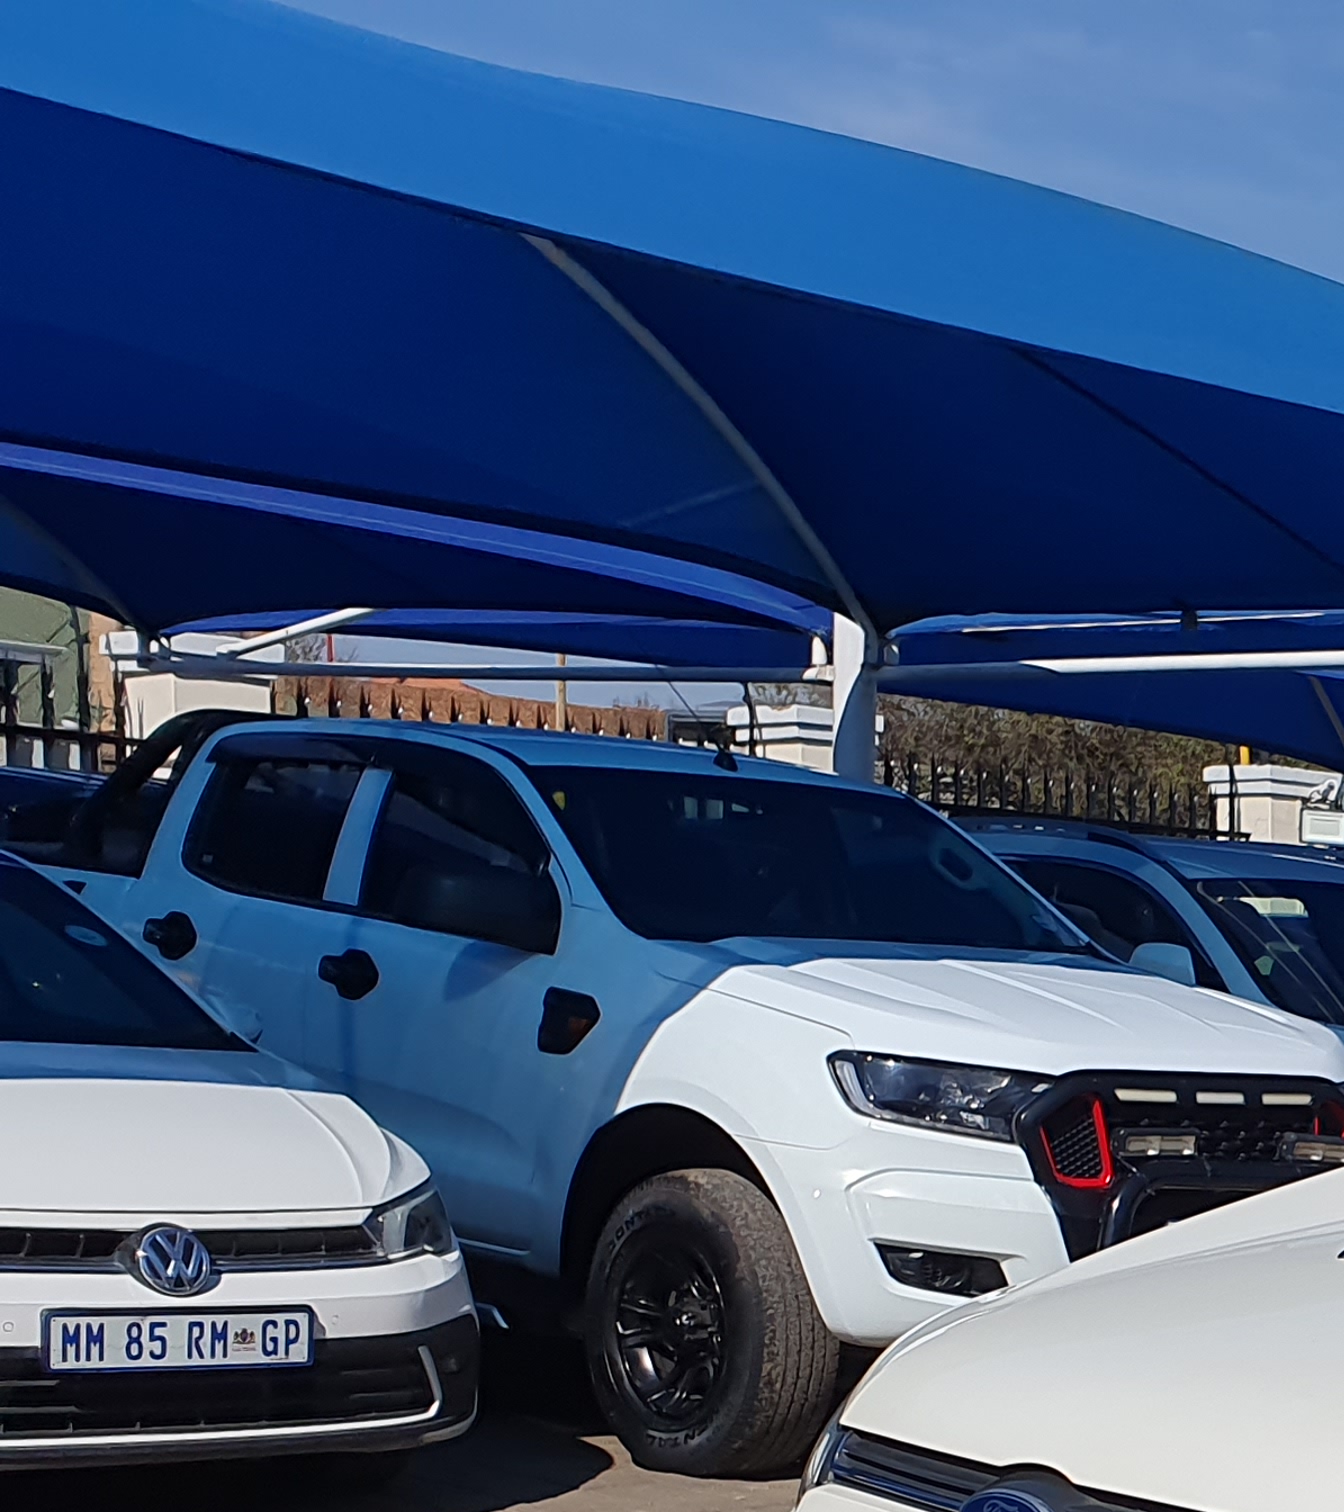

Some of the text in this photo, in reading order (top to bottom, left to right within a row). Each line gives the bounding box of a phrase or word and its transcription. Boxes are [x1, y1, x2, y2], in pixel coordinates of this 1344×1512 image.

[61, 1319, 301, 1363] MM 85 RM GP
